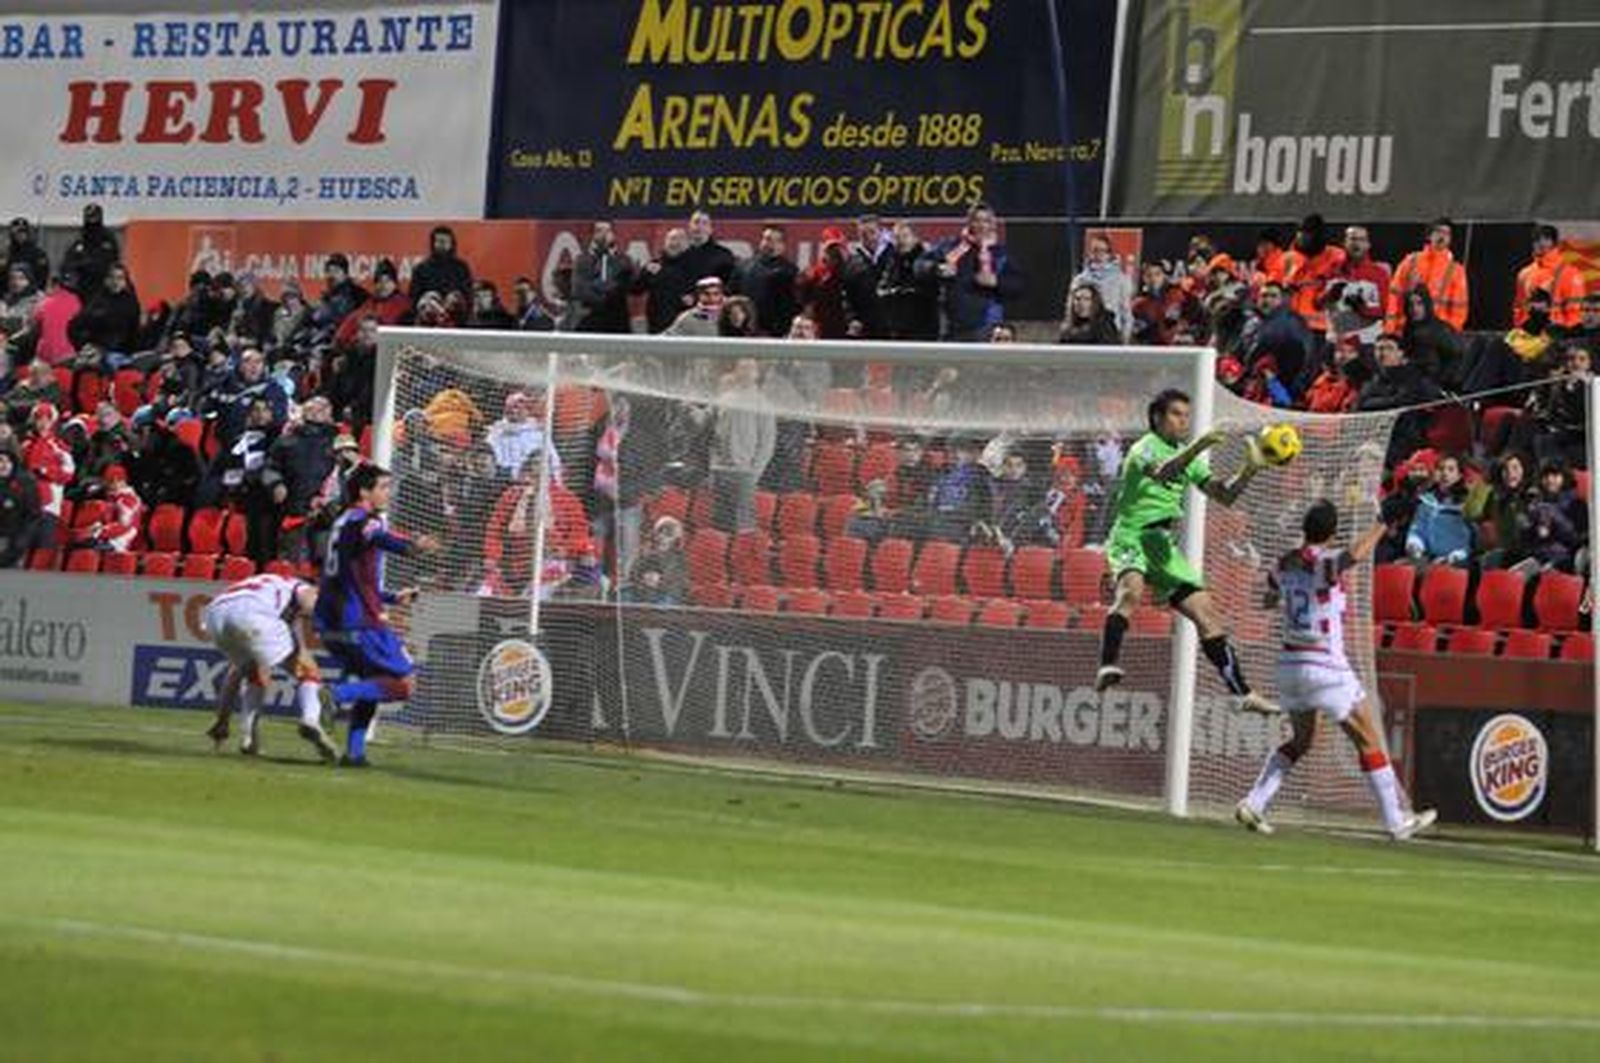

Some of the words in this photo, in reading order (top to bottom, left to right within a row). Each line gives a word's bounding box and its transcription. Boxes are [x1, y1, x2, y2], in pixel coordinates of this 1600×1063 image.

[1, 24, 84, 59] BAR
[133, 13, 474, 59] RESTAURANTE
[59, 77, 398, 145] HERVI
[612, 83, 816, 151] ARENAS
[822, 111, 908, 148] desde
[916, 114, 984, 148] 1888
[59, 175, 142, 199] SANTA
[318, 175, 420, 200] HUESCA
[666, 176, 703, 207] EN
[707, 175, 854, 206] SERVICIOS
[858, 163, 985, 207] ÓPTICOS
[1233, 113, 1394, 195] borau
[641, 628, 886, 748] VINCI
[962, 678, 1162, 751] BURGER
[1485, 754, 1540, 793] KING
